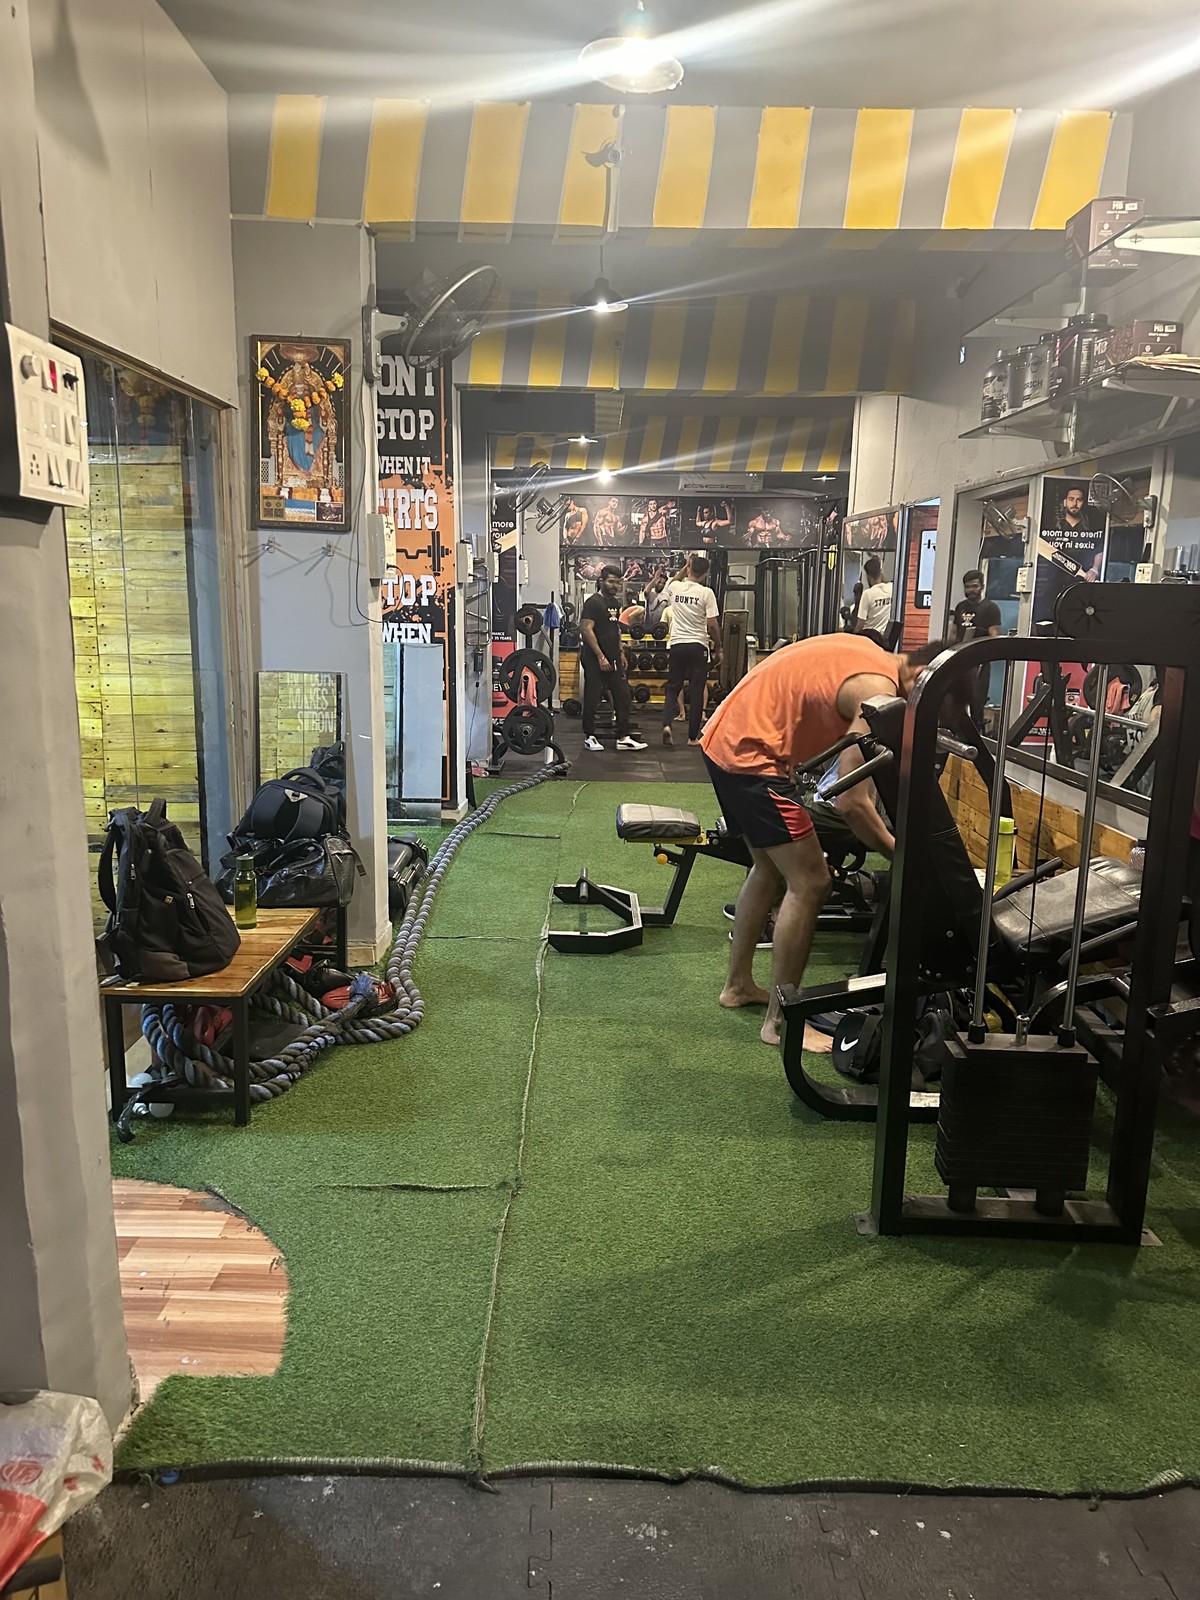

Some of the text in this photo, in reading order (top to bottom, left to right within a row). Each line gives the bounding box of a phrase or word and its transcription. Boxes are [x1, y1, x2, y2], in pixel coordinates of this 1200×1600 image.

[378, 408, 435, 440] STOP
[416, 456, 431, 475] IT
[675, 595, 699, 605] BUNTY
[288, 687, 329, 710] MAKES
